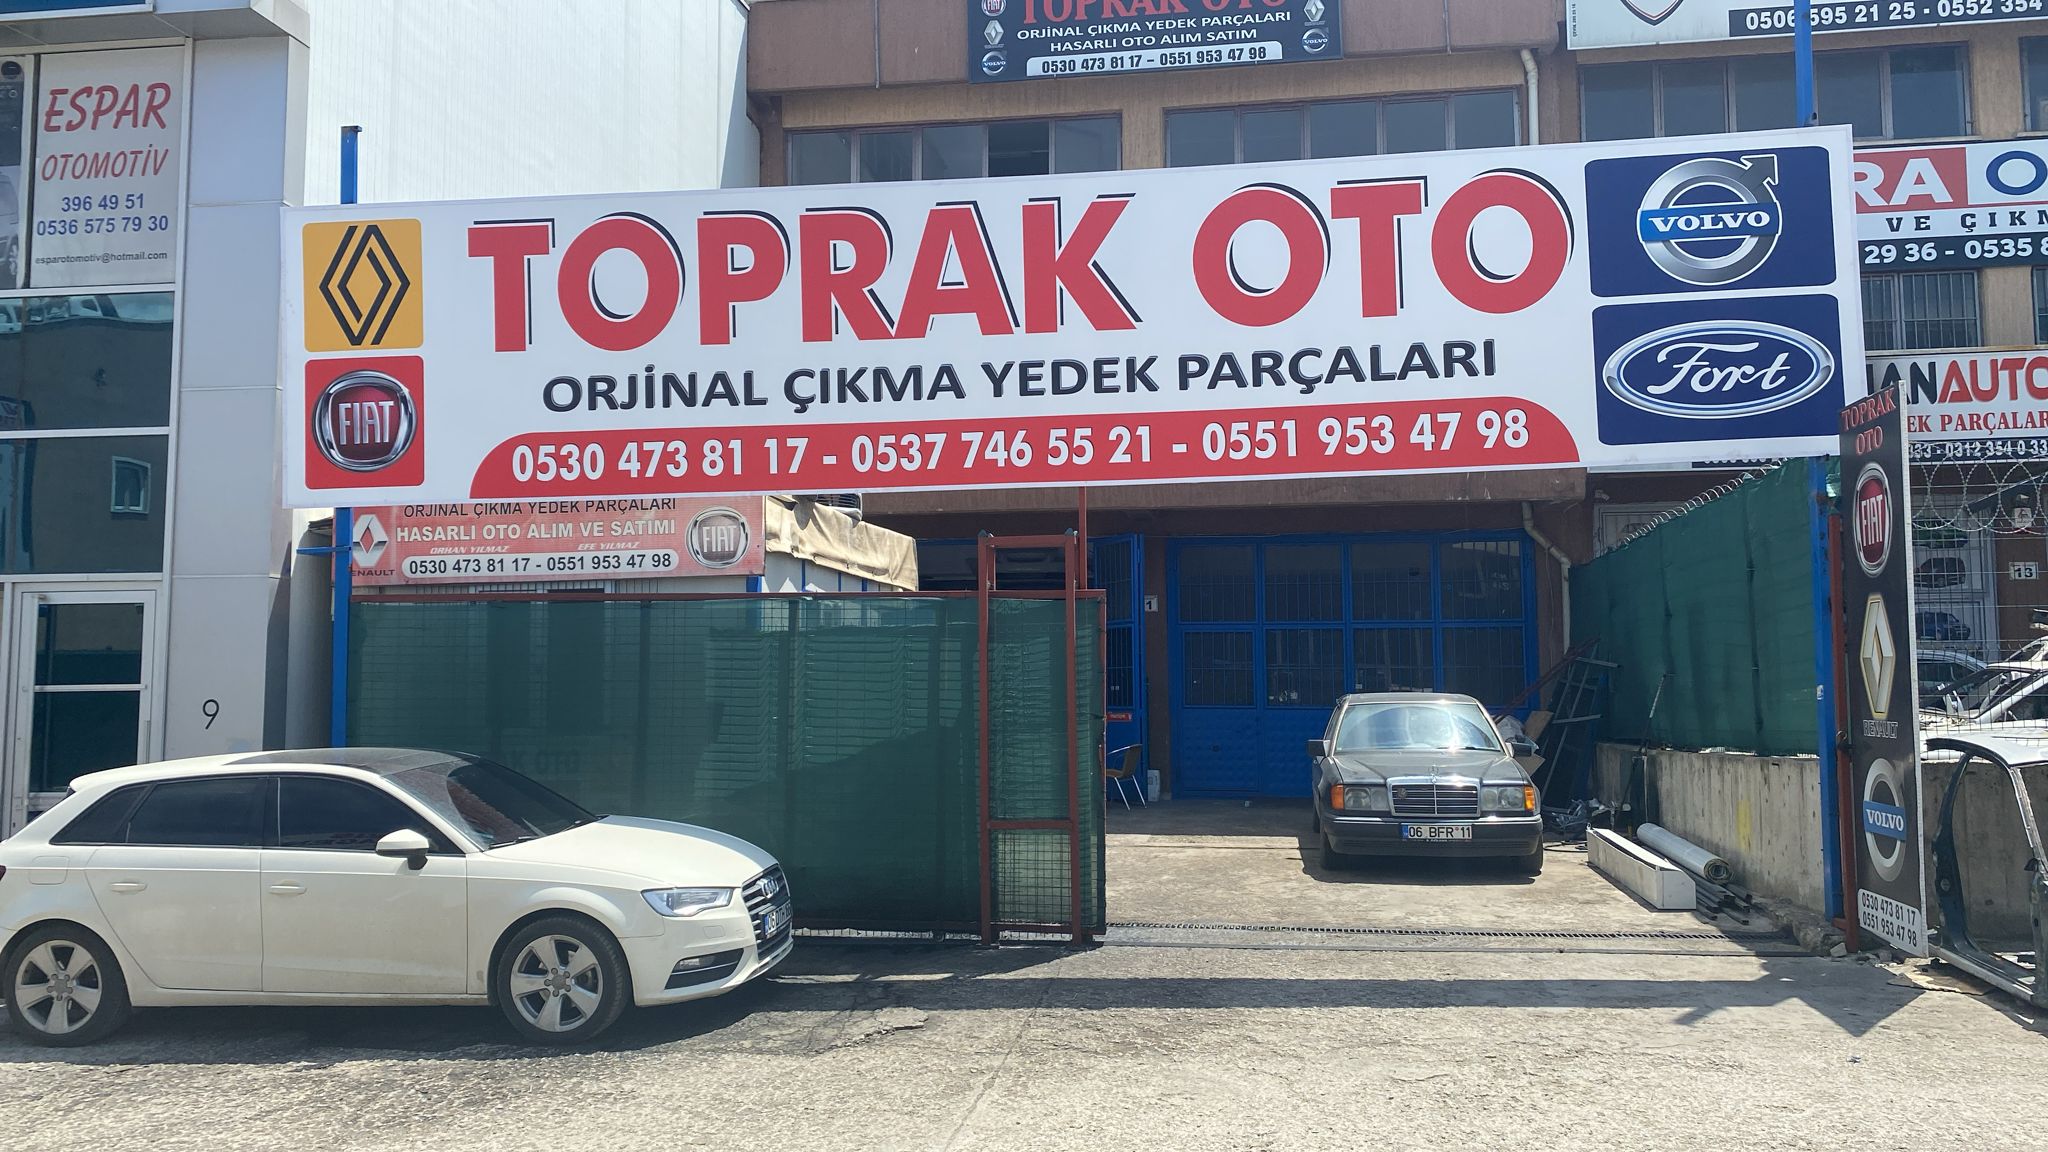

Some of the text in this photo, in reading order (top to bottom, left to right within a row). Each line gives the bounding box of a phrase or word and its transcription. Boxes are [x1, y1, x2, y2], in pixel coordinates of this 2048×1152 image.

[1017, 26, 1084, 40] ORJİNAL
[1088, 22, 1142, 36] ÇIKMA
[1146, 18, 1197, 31] YEDEK
[1202, 11, 1291, 26] PARÇALARI
[1810, 6, 1847, 26] 595
[1855, 4, 1878, 22] 21
[1889, 2, 1916, 20] 25
[1937, 0, 1993, 17] 0552
[1050, 29, 1257, 52] HASARLI OTO ALIM SATIM
[1042, 59, 1076, 73] 0530
[1081, 57, 1105, 71] 473
[1110, 56, 1124, 69] 81
[1129, 55, 1142, 67] 17
[1160, 51, 1191, 66] 0551
[1196, 49, 1222, 63] 953
[1227, 48, 1244, 61] 47
[1248, 46, 1267, 59] 98
[44, 83, 171, 132] ESPAR
[41, 144, 169, 181] OTOMOTİV
[61, 194, 144, 212] 396 49 51
[37, 216, 168, 236] 0536 575 79 30
[1648, 211, 1770, 232] VOLVO
[1886, 216, 1931, 232] VE
[35, 252, 167, 265] esparotomotiv@hotmail.com
[467, 167, 1575, 353] TOPRAK OTO
[1864, 244, 1897, 264] 29
[1904, 242, 1937, 262] 36
[1964, 238, 2033, 259] 0535
[542, 339, 1496, 413] ORJİNAL ÇIKMA YEDEK PARÇALARI
[1647, 342, 1790, 394] Fort
[338, 401, 394, 445] FIAT
[1841, 388, 1897, 432] TOPRAK
[512, 442, 605, 481] 0530
[618, 438, 688, 478] 473
[702, 438, 743, 476] 81
[763, 436, 808, 474] 17
[850, 433, 945, 473] 0537
[961, 430, 1032, 469] 746
[1045, 426, 1093, 466] 55
[1108, 425, 1152, 463] 21
[1202, 420, 1298, 460] 0551
[1317, 415, 1395, 456] 953
[1410, 412, 1461, 453] 47
[1477, 409, 1529, 450] 98
[1855, 426, 1883, 456] OTO
[474, 503, 522, 518] ÇIKMA
[528, 501, 580, 514] YEDEK
[586, 498, 676, 514] PARÇALARI
[1861, 495, 1883, 547] FIAT
[396, 519, 675, 542] HASARLI OTO ALIM VE SATIMI
[702, 525, 737, 552] FIAT
[470, 545, 510, 553] YILMAZ
[599, 542, 640, 550] YILMAZ
[409, 560, 447, 574] 0530
[452, 559, 481, 573] 473
[487, 558, 504, 572] 81
[512, 558, 530, 571] 17
[547, 556, 585, 571] 0551
[591, 555, 621, 570] 953
[626, 554, 646, 568] 47
[652, 553, 671, 567] 98
[2015, 567, 2033, 578] 13
[202, 699, 219, 730] 9
[1863, 719, 1898, 739] RENAULT
[1408, 827, 1423, 838] 06
[1429, 827, 1454, 838] BFR
[1461, 827, 1471, 838] 11
[1866, 809, 1904, 832] VOLVO
[1861, 891, 1916, 926] 0530 473 81 17
[1862, 911, 1917, 947] 0551 953 47 98
